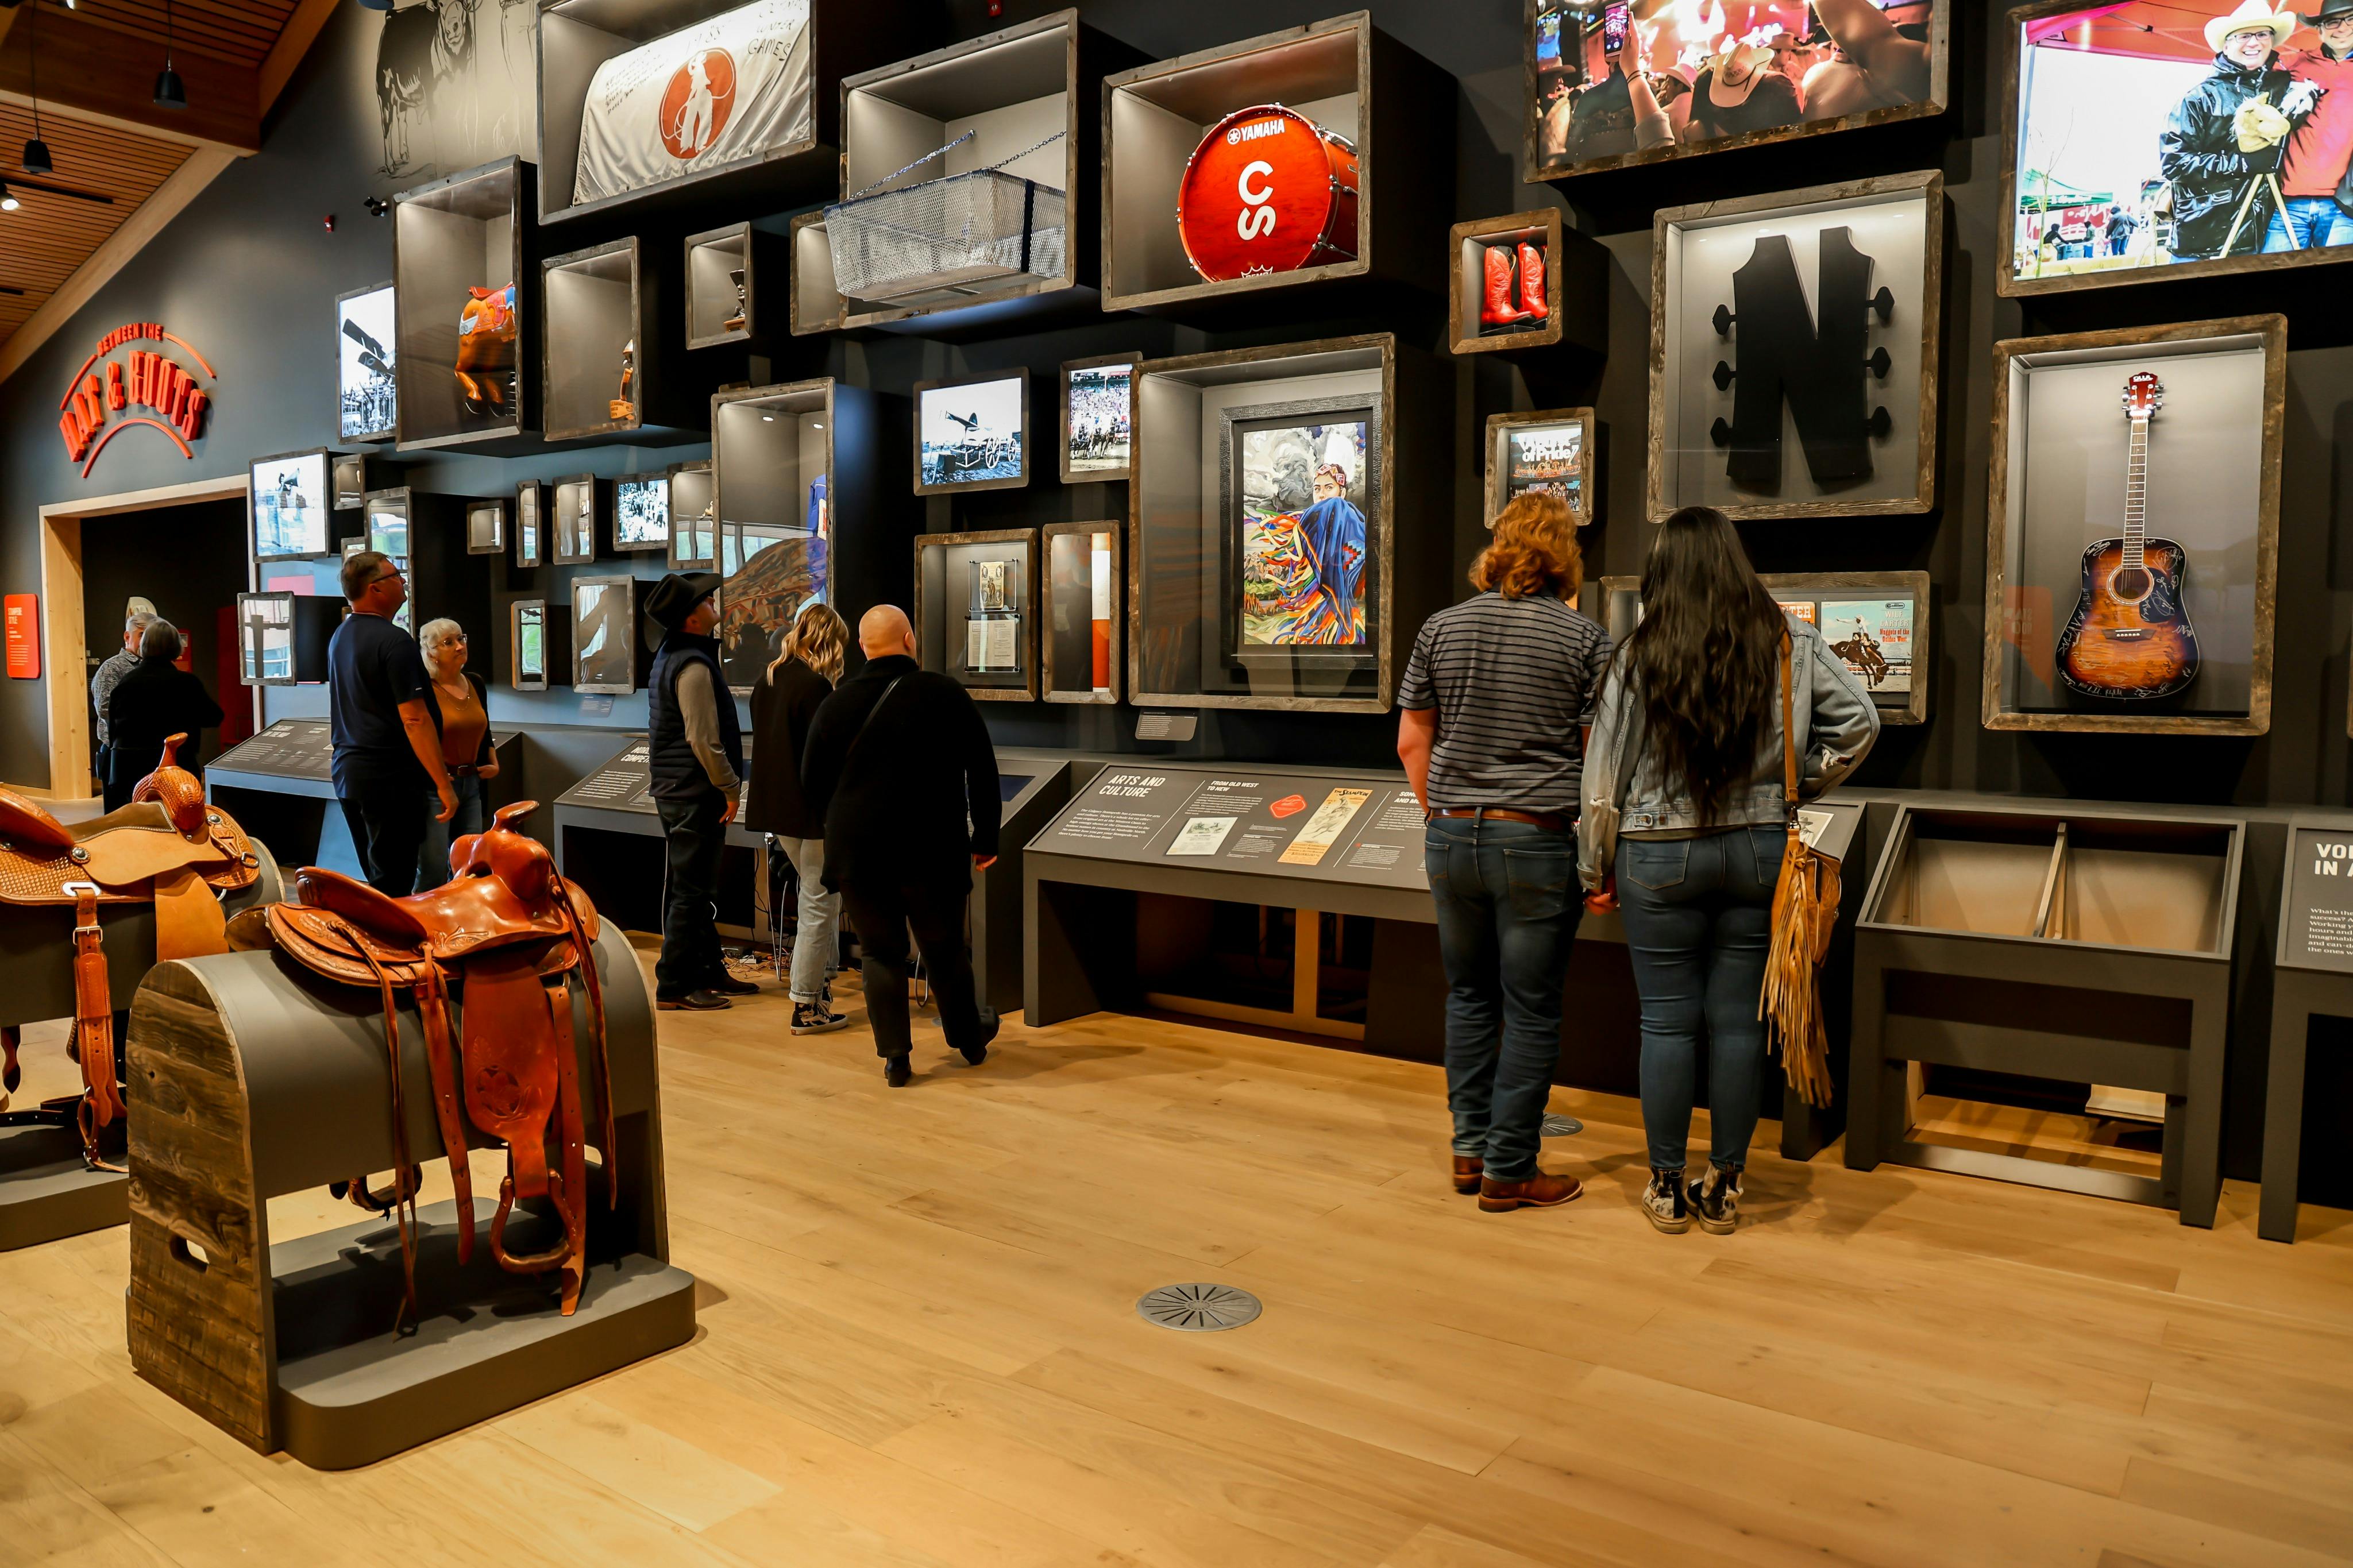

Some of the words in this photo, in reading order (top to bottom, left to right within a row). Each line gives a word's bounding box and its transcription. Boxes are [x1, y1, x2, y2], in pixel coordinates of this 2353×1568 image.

[748, 38, 792, 61] GAMES
[1241, 119, 1285, 142] YAMAHA
[97, 323, 142, 357] BETWEEN
[142, 322, 164, 341] THE
[59, 374, 105, 462] HAT
[106, 361, 126, 411] &
[128, 350, 208, 442] BOOTS
[1536, 447, 1571, 461] Pride
[1885, 611, 1903, 619] WILF
[1108, 775, 1141, 785] ARTS
[1139, 777, 1166, 787] AND
[1099, 785, 1152, 797] CULTURE
[2315, 860, 2338, 876] IN
[2309, 921, 2346, 929] Working
[2309, 934, 2353, 942] imaginabl
